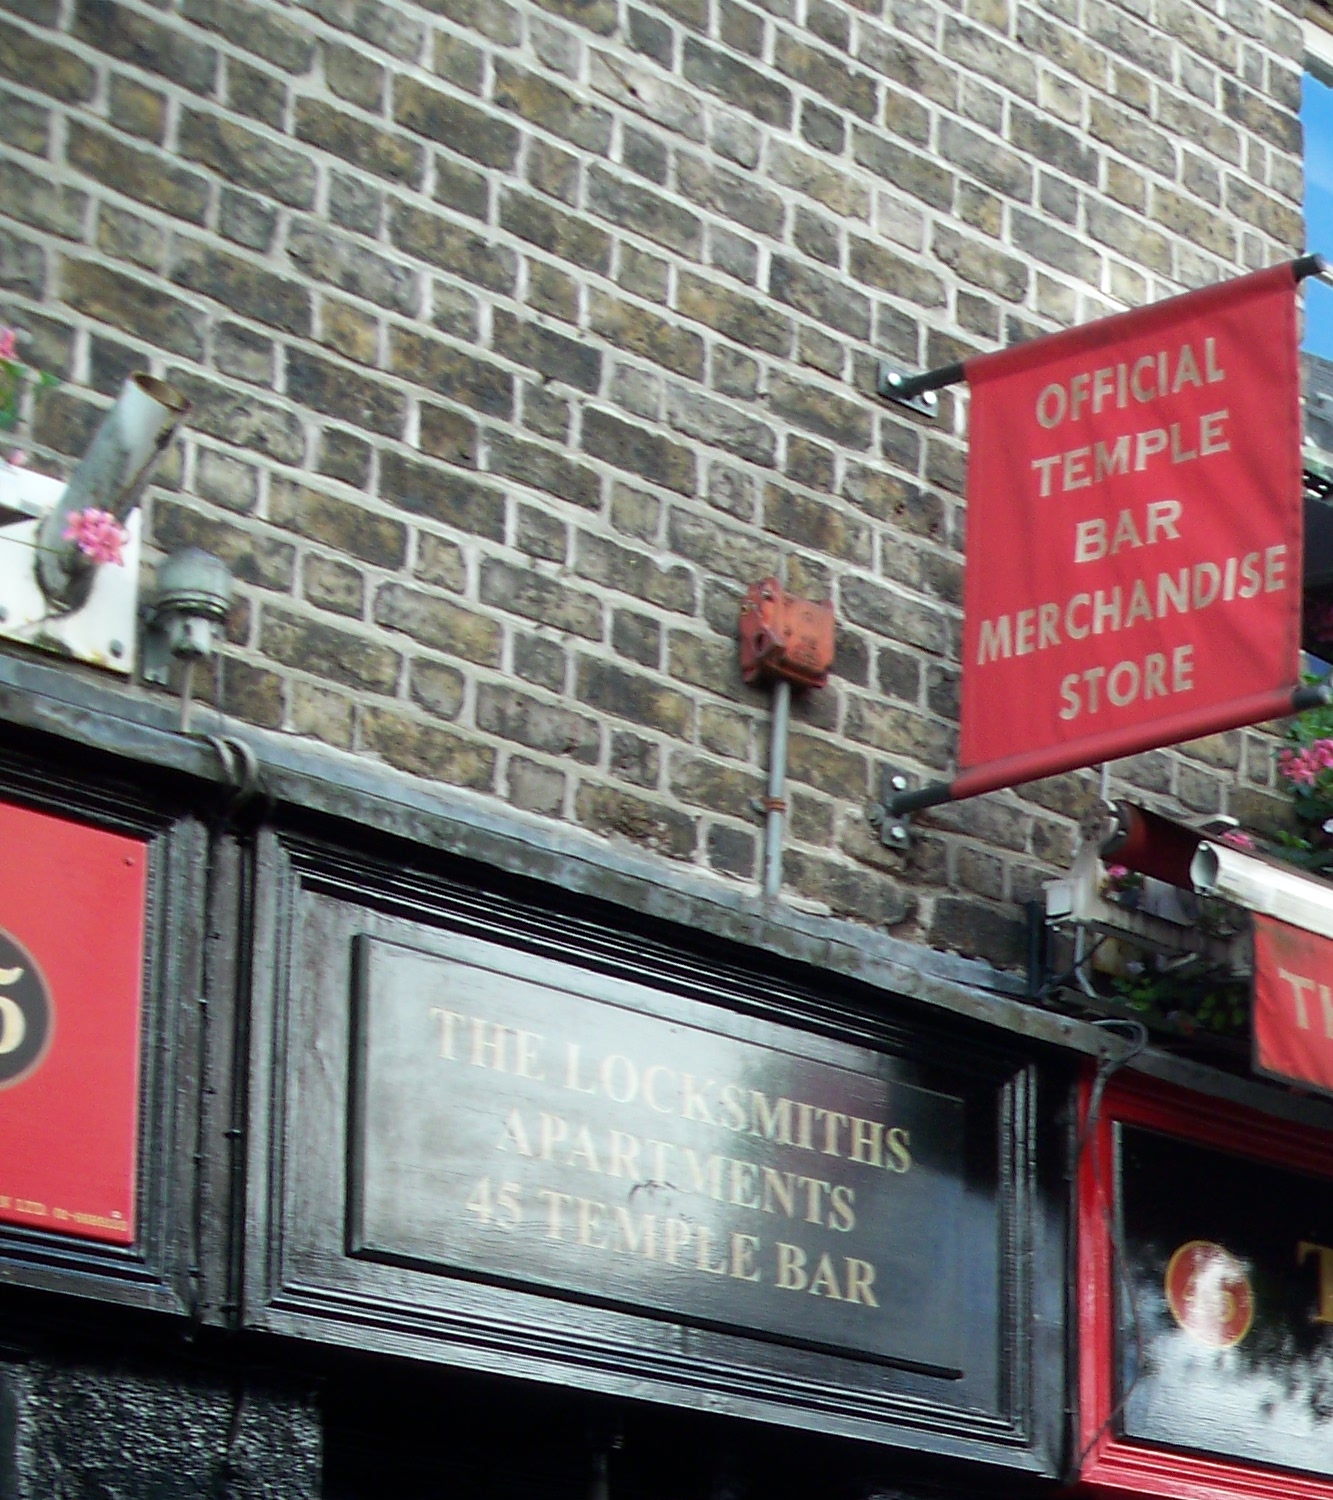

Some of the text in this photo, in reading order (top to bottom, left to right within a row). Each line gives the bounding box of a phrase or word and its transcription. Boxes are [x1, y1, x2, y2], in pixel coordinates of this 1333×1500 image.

[1036, 337, 1226, 429] OFFICIAL
[1031, 410, 1231, 498] TEMPLE
[1074, 499, 1183, 564] BAR
[977, 544, 1288, 666] MERCHANDISE
[1058, 644, 1195, 721] STORE
[430, 1008, 913, 1175] THE LOCKSMITHS
[496, 1106, 858, 1232] APARTMENTS
[463, 1170, 879, 1309] 45 TEMPLE BAR
